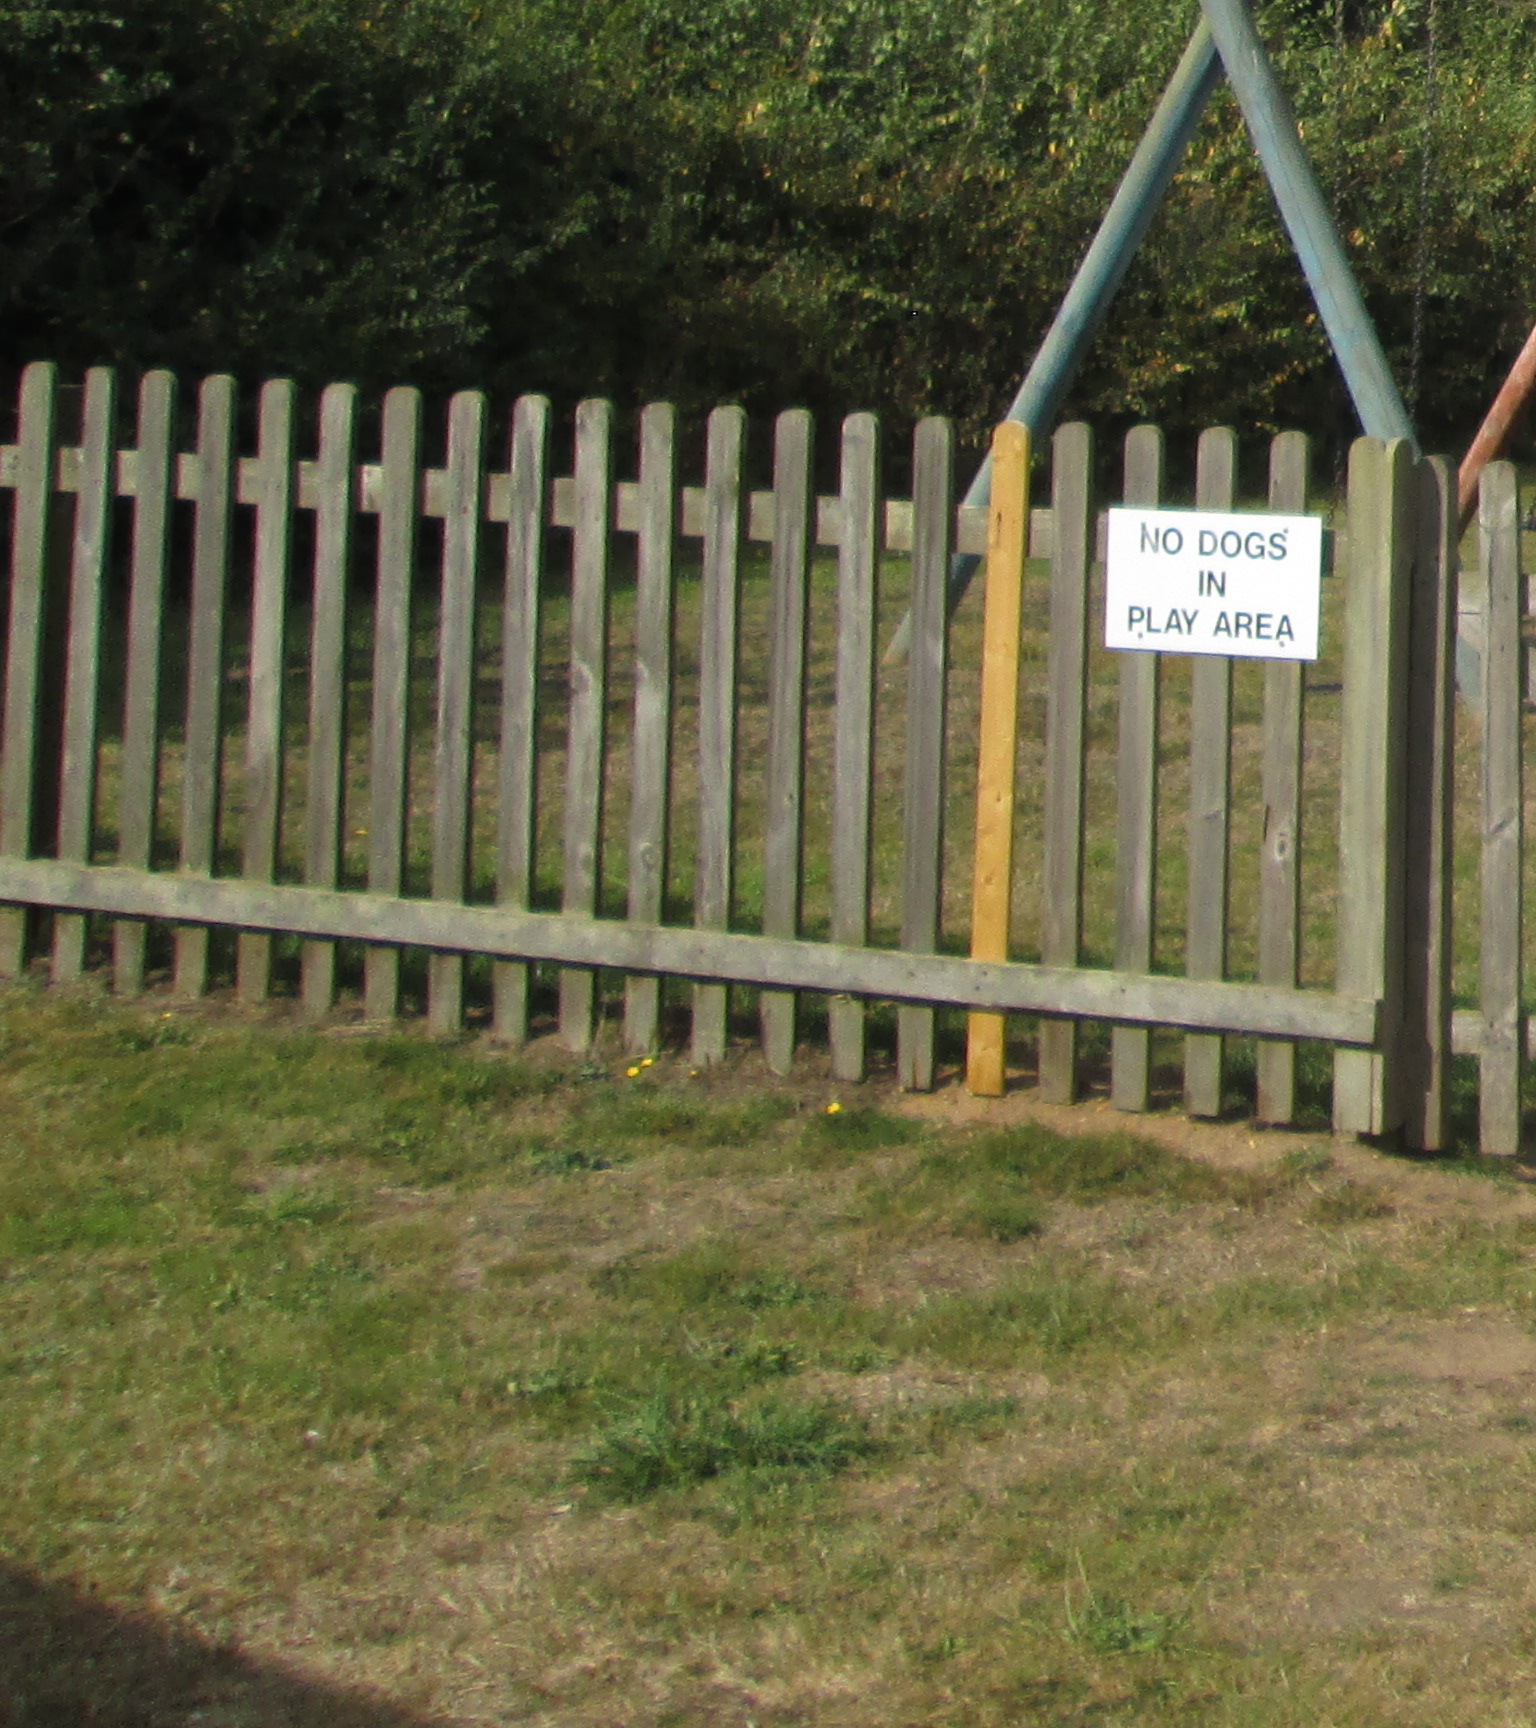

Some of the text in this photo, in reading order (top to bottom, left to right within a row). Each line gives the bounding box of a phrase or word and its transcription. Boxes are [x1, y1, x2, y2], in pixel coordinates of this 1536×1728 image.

[1140, 526, 1288, 560] NO DOGS
[1198, 570, 1226, 598] IN
[1127, 605, 1295, 641] PLAY AREA
